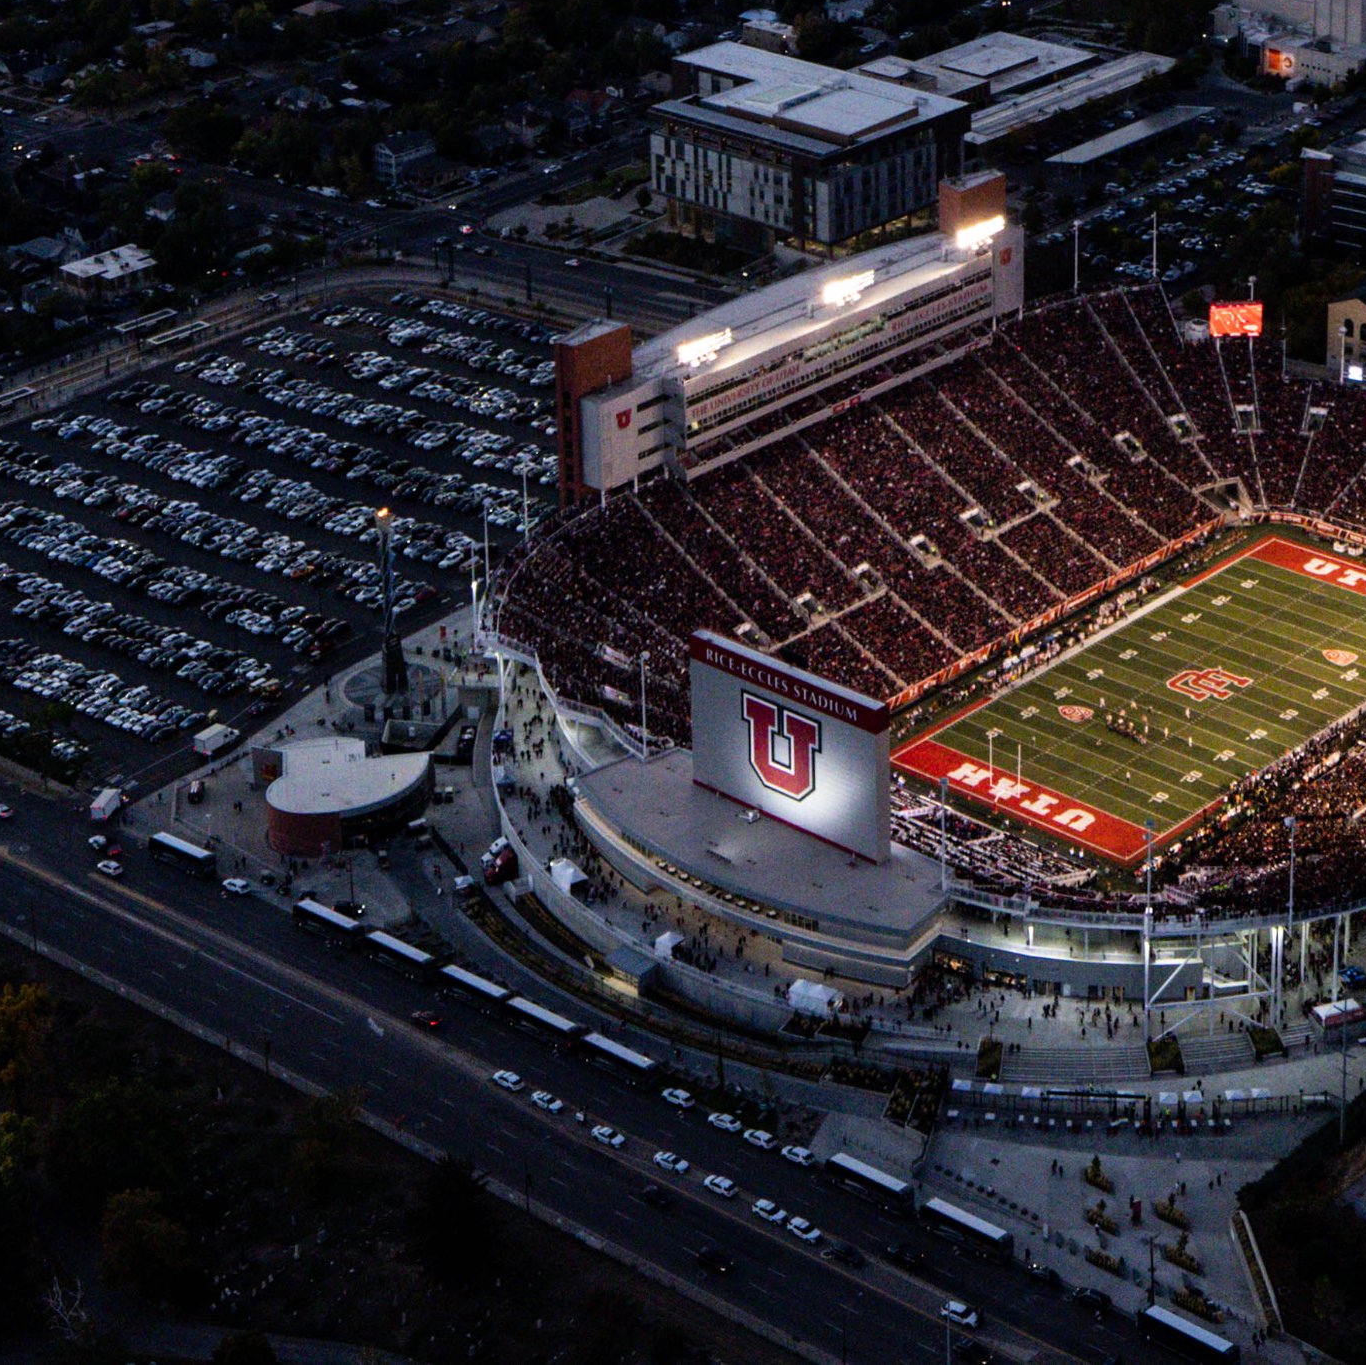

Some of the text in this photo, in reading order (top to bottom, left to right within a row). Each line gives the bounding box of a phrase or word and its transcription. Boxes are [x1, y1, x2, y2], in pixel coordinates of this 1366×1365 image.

[616, 409, 632, 429] U
[691, 364, 800, 418] THE UNIVERSITY OF UTAH
[705, 648, 858, 722] RICE-ECCLES STADIUM
[741, 688, 822, 802] U
[947, 762, 1096, 832] UTAH
